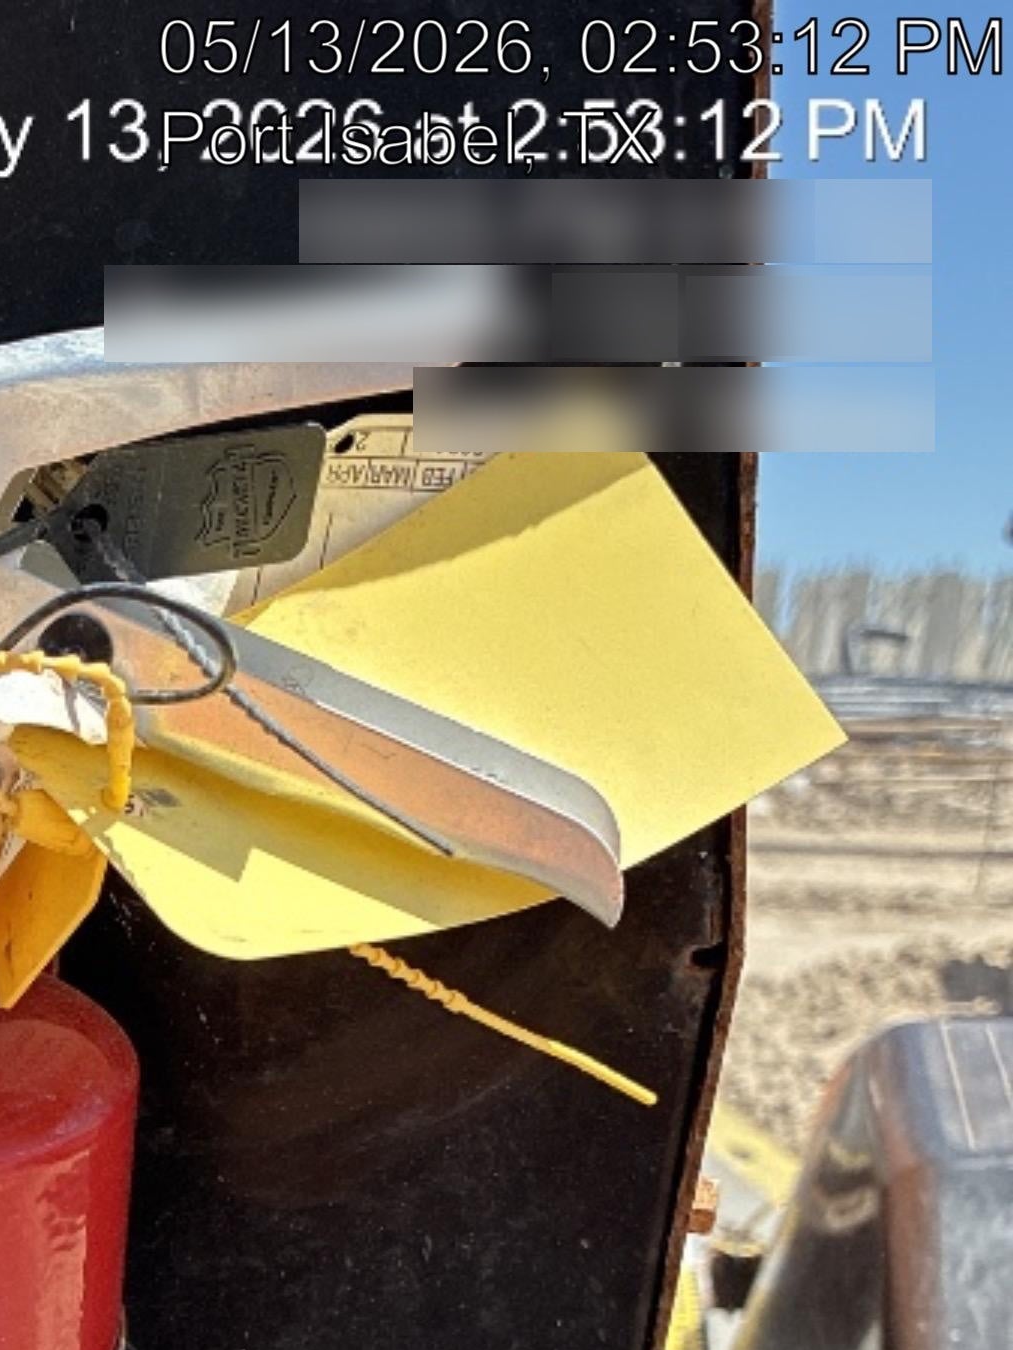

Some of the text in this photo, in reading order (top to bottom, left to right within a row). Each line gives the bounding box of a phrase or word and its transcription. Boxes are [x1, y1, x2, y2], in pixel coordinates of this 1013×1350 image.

[326, 462, 456, 487] FEB MAR APR
